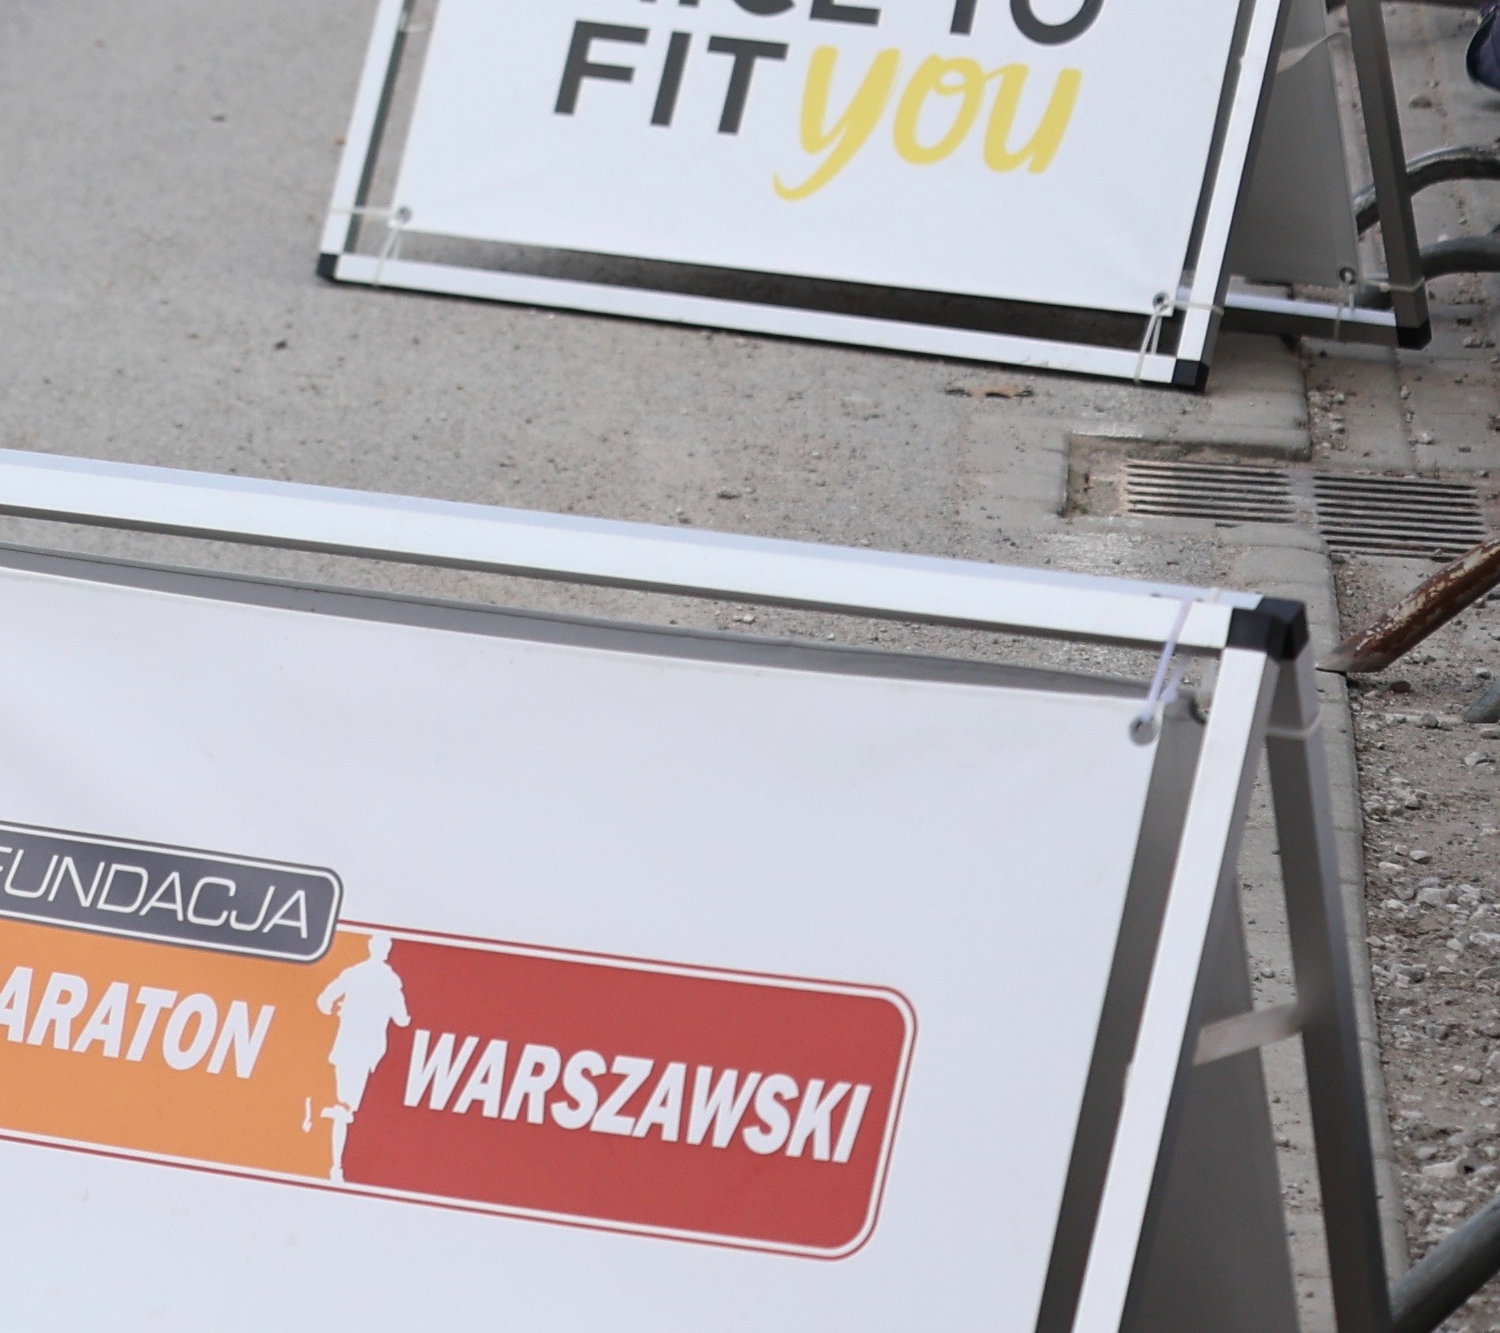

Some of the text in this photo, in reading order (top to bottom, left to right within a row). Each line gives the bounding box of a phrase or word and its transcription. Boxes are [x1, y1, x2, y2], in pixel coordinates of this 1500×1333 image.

[553, 19, 1083, 202] FIT you
[402, 1029, 871, 1165] WARSZAWSKI
